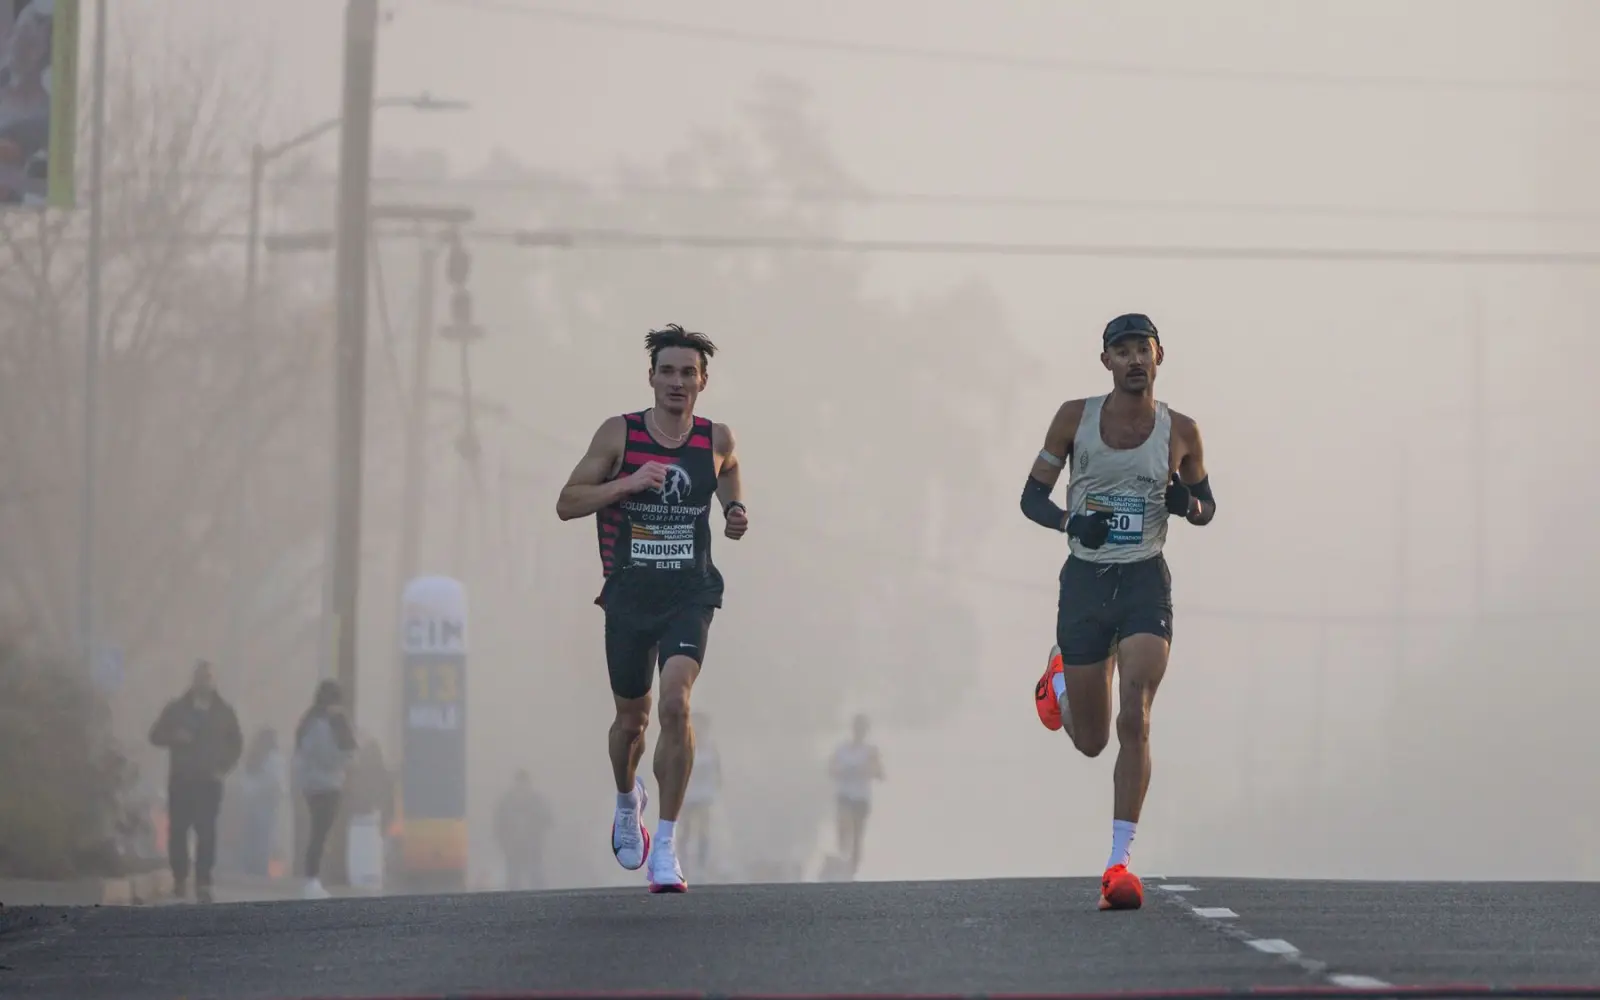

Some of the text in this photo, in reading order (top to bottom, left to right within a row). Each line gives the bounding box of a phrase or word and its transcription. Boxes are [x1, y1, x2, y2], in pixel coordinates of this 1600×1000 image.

[619, 500, 669, 514] COLUMBUS
[1102, 500, 1143, 508] INTERNATIONAL
[642, 514, 686, 522] COMPANY
[632, 543, 693, 556] SANDUSKY
[656, 560, 681, 569] ELITE
[406, 618, 462, 647] CIM
[412, 666, 457, 700] 13
